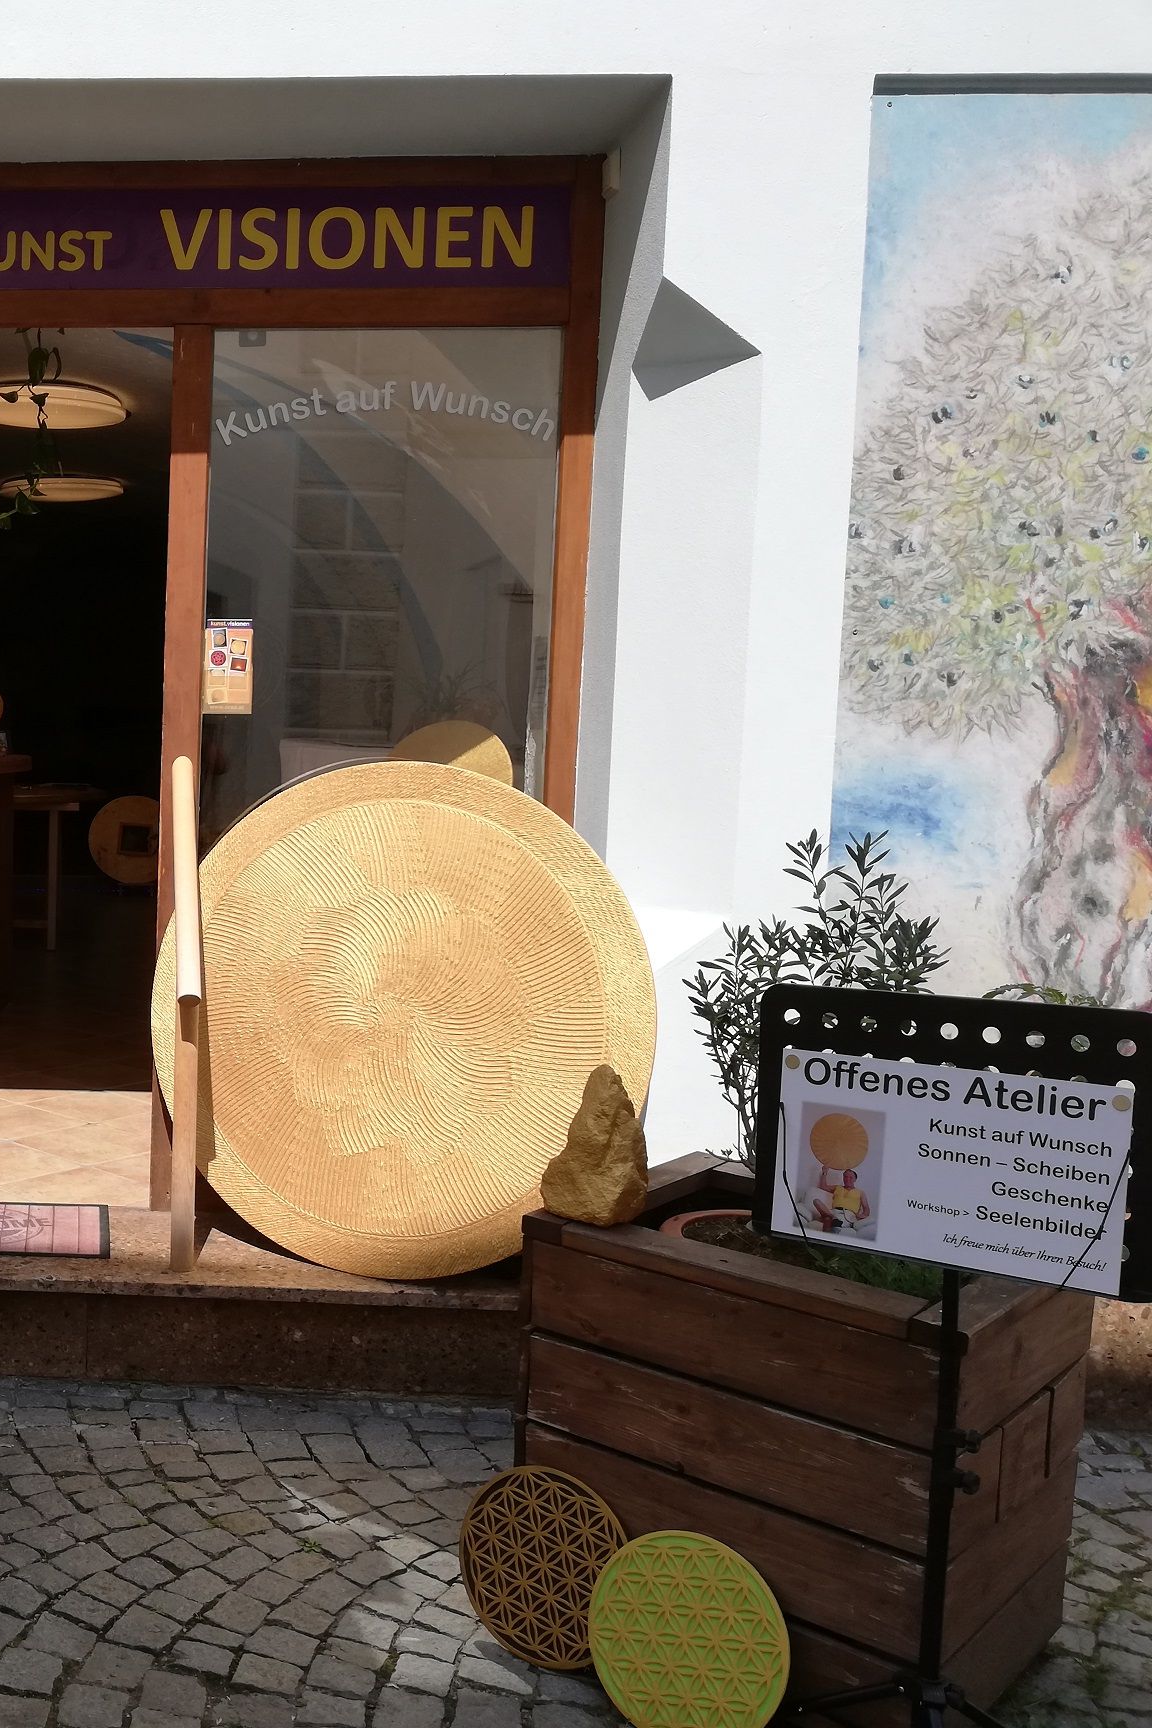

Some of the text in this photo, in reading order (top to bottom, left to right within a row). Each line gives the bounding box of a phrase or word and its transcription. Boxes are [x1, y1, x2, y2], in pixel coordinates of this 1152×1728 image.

[160, 205, 535, 271] VISIONEN
[215, 381, 557, 446] Kunst auf Wunsch
[804, 1057, 1107, 1121] Offenes Atelier
[929, 1118, 1113, 1158] Kunst auf Wunsch
[917, 1143, 991, 1168] Sonnen
[1012, 1157, 1111, 1186] Scheiben
[991, 1181, 1109, 1214] Geschenke
[906, 1199, 960, 1218] Workshop
[975, 1205, 1107, 1241] Seelenbilder
[942, 1233, 1108, 1273] Ich freue mich über Ihren Besuch!
